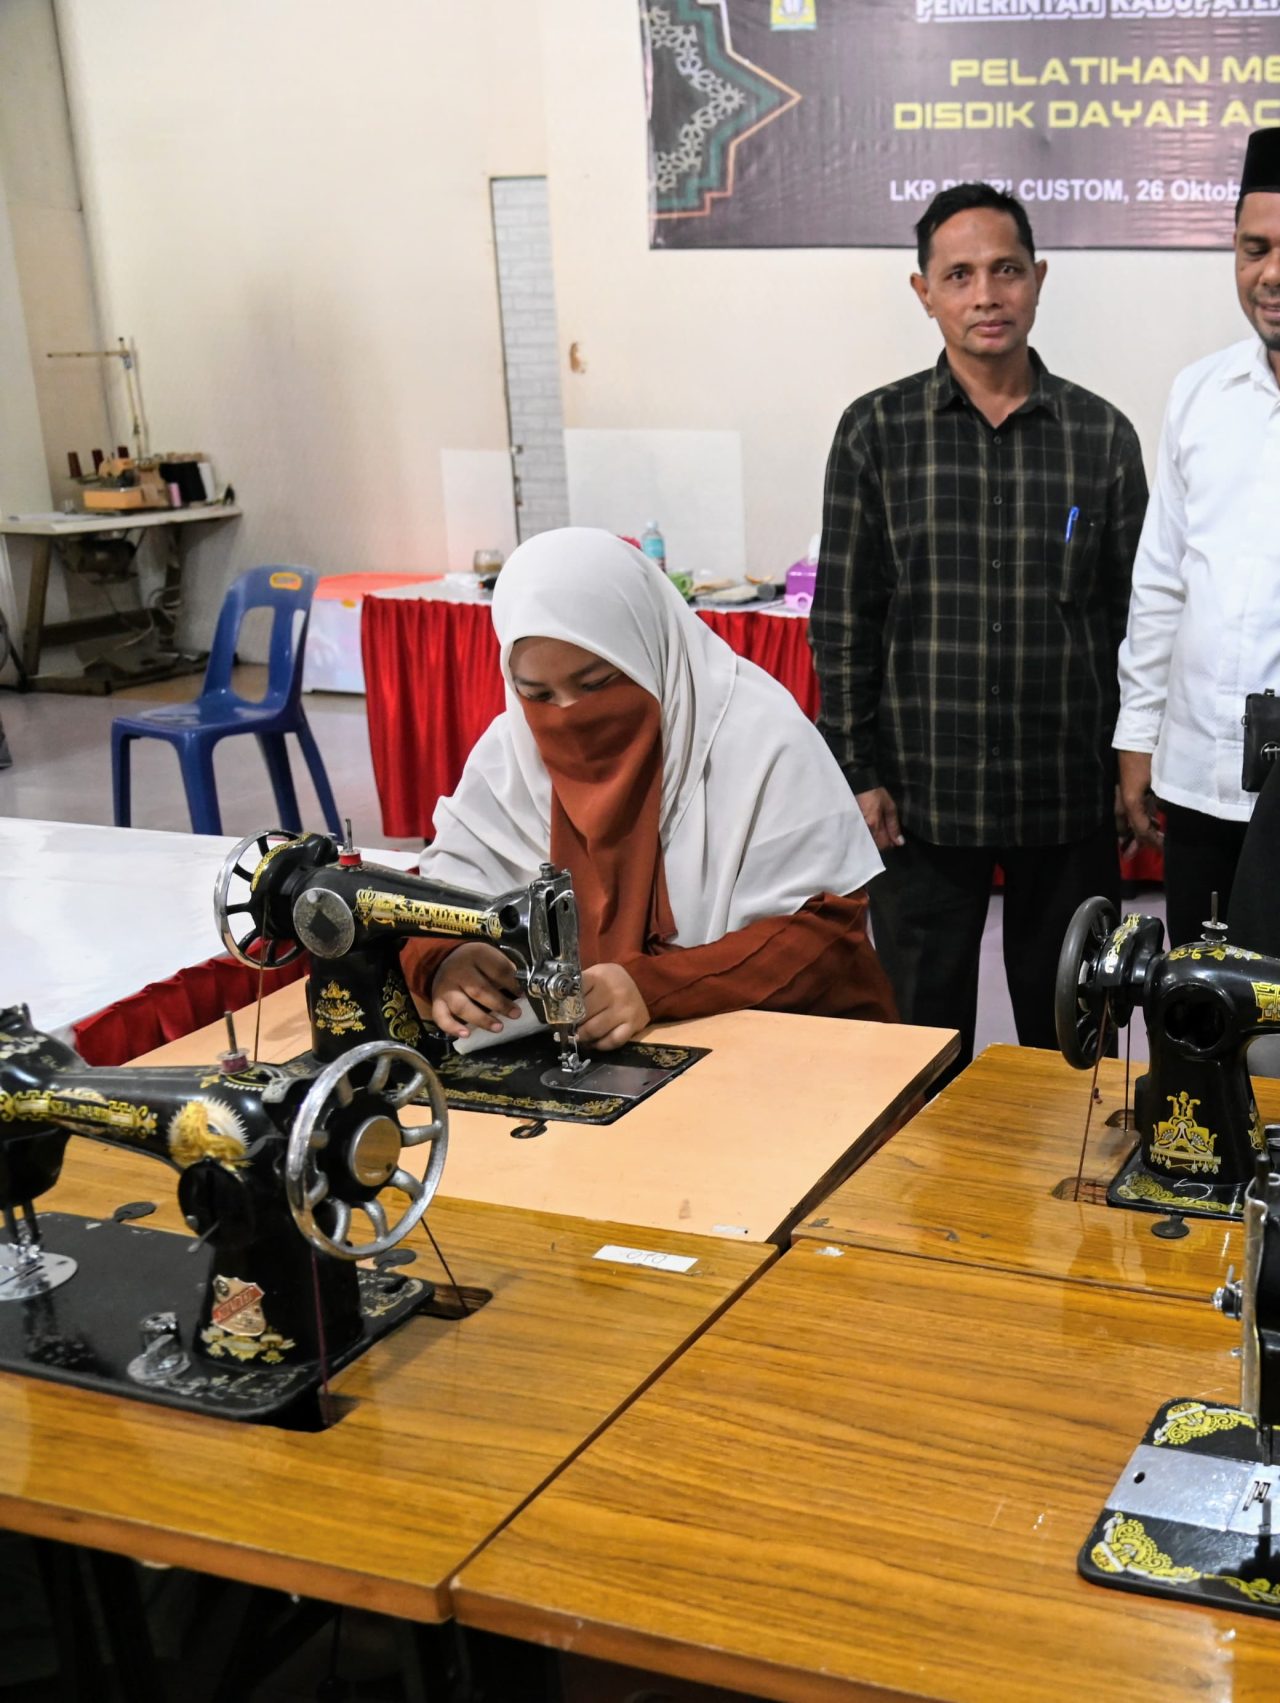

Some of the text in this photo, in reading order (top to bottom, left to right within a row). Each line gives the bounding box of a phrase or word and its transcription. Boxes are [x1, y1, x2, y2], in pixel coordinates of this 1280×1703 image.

[950, 56, 1211, 86] PELATIHAN
[894, 101, 1035, 129] DISDIK
[1048, 100, 1208, 128] DAYAH
[890, 180, 936, 201] LKP
[1019, 179, 1129, 204] CUSTOM,
[1136, 179, 1164, 201] 26
[1170, 178, 1241, 201] Oktob
[399, 901, 479, 926] STANDARD
